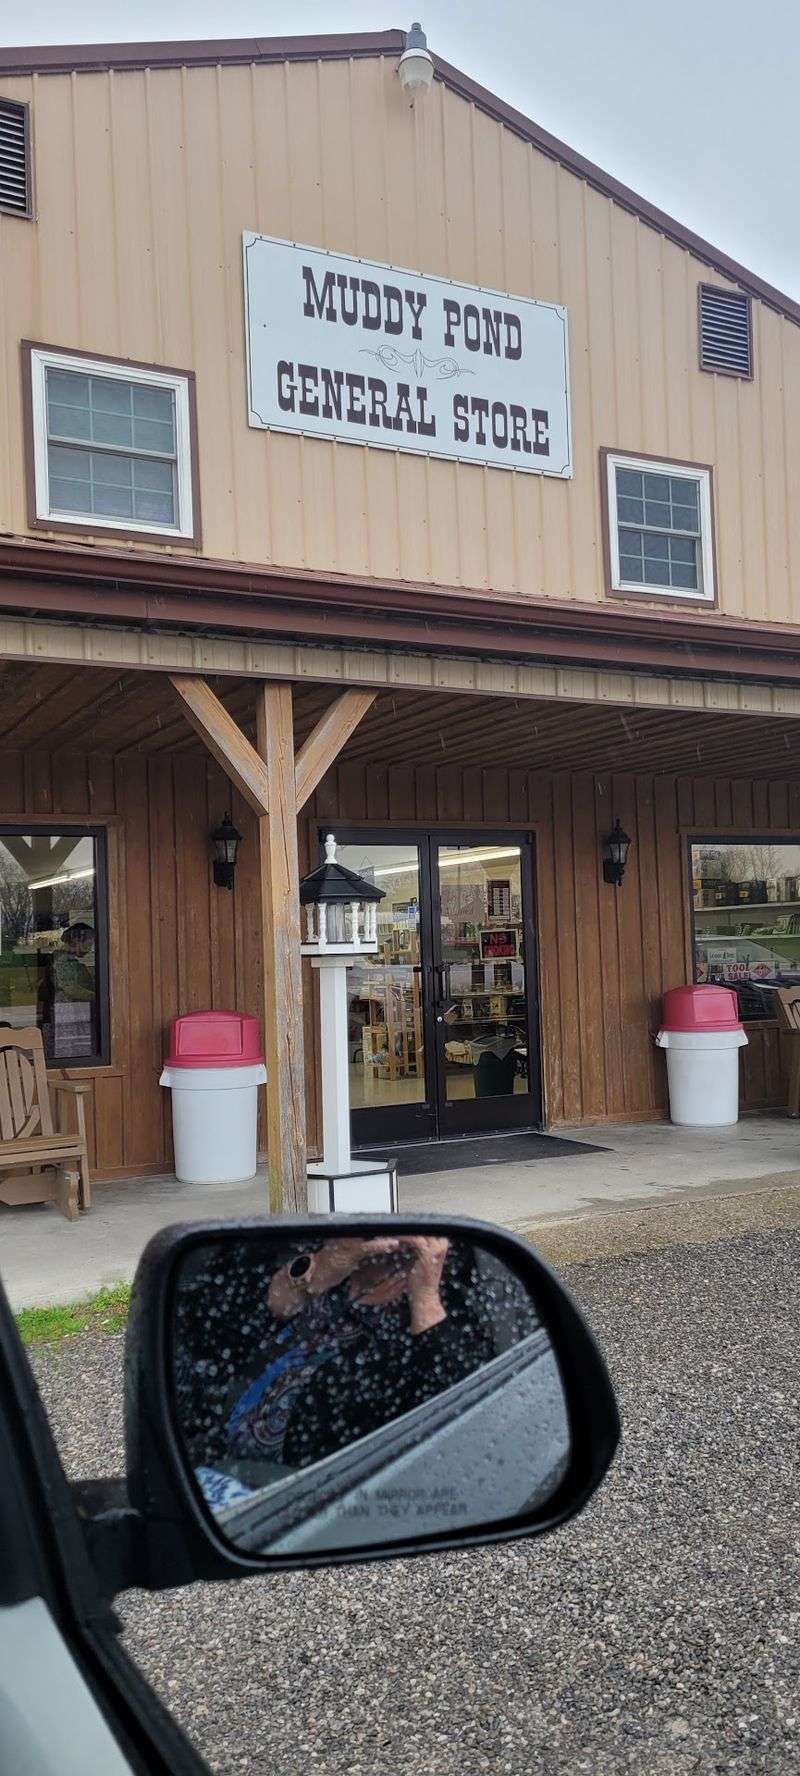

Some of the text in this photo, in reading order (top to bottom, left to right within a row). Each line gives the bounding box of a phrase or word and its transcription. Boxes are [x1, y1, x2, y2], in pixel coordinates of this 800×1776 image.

[302, 265, 523, 361] MUDDY POND
[276, 360, 550, 456] GENERAL STORE
[727, 963, 750, 972] TOOL
